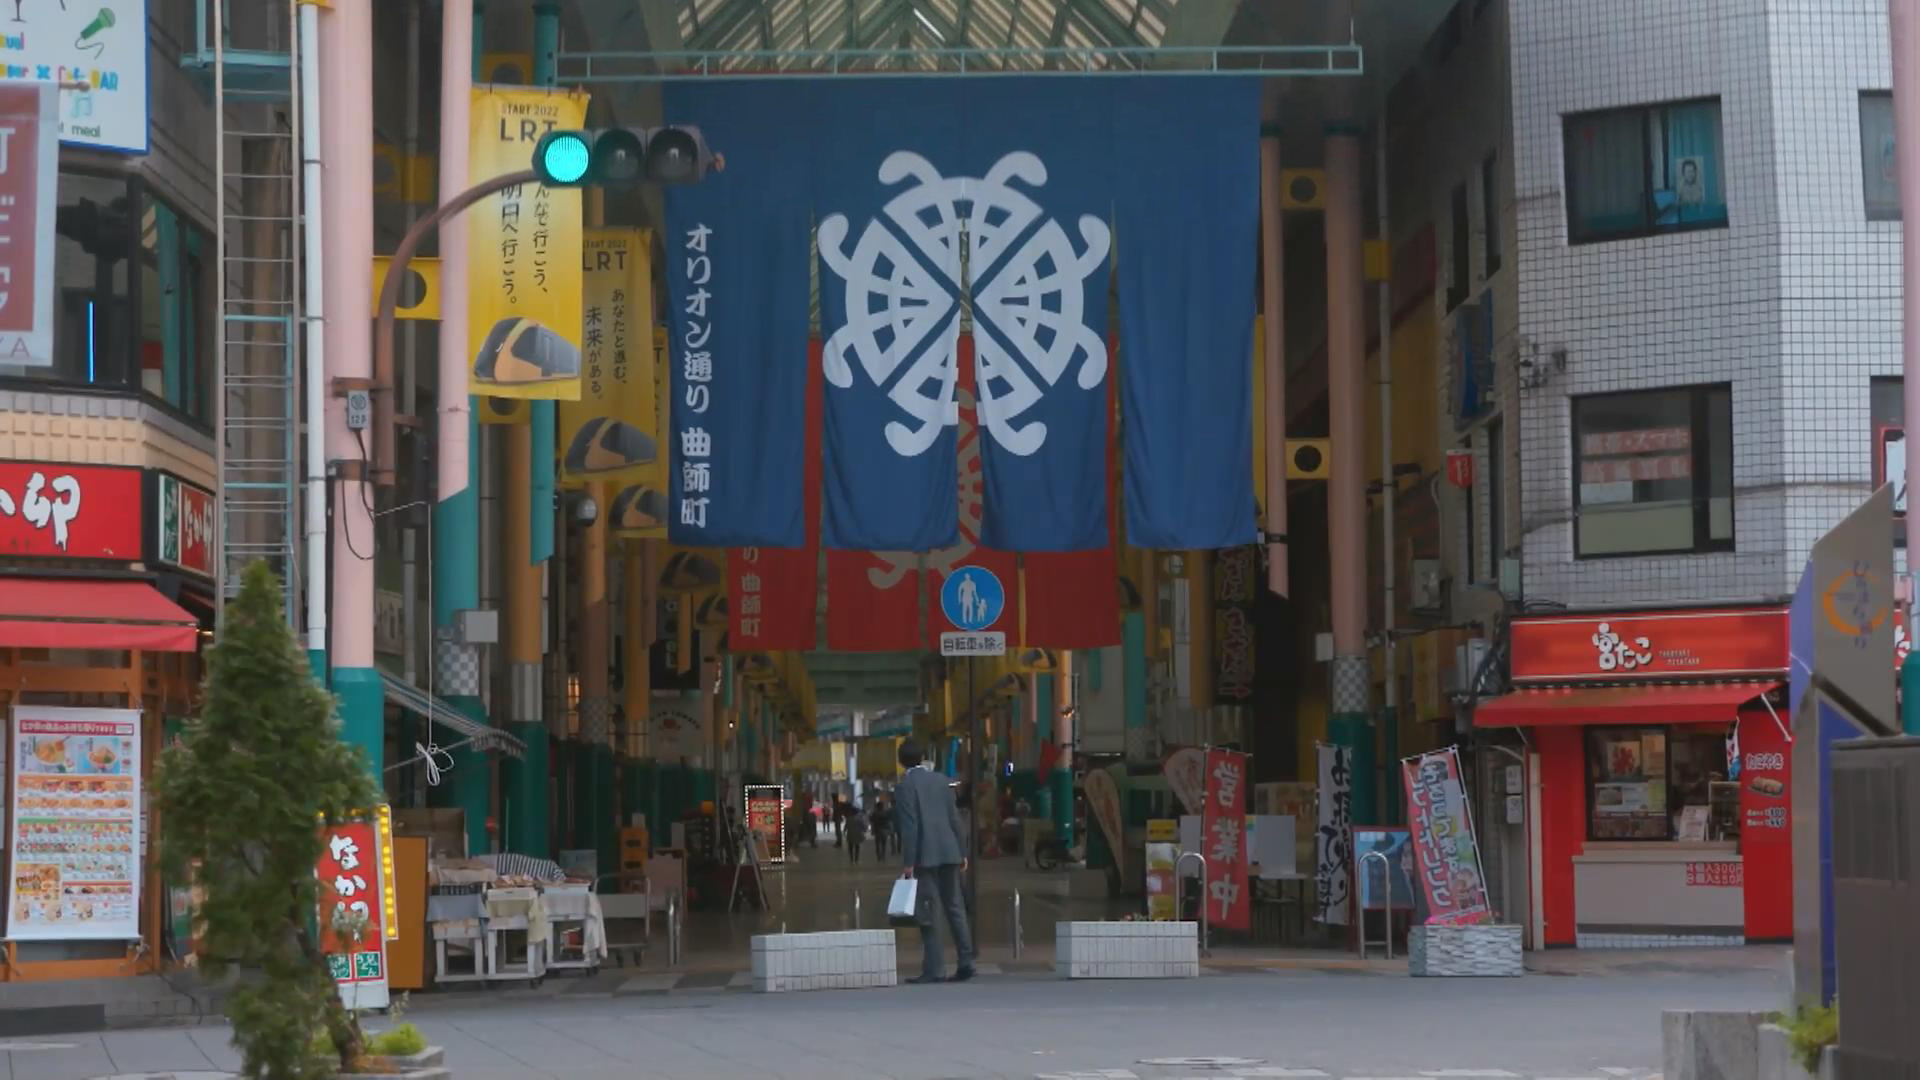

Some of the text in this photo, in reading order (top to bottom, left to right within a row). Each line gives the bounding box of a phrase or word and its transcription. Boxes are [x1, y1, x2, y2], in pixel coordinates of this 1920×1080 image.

[583, 250, 628, 272] LRT
[681, 223, 713, 528] オリオン通り 曲師町
[1591, 622, 1652, 671] 宮たこ
[1208, 760, 1241, 921] 営業中
